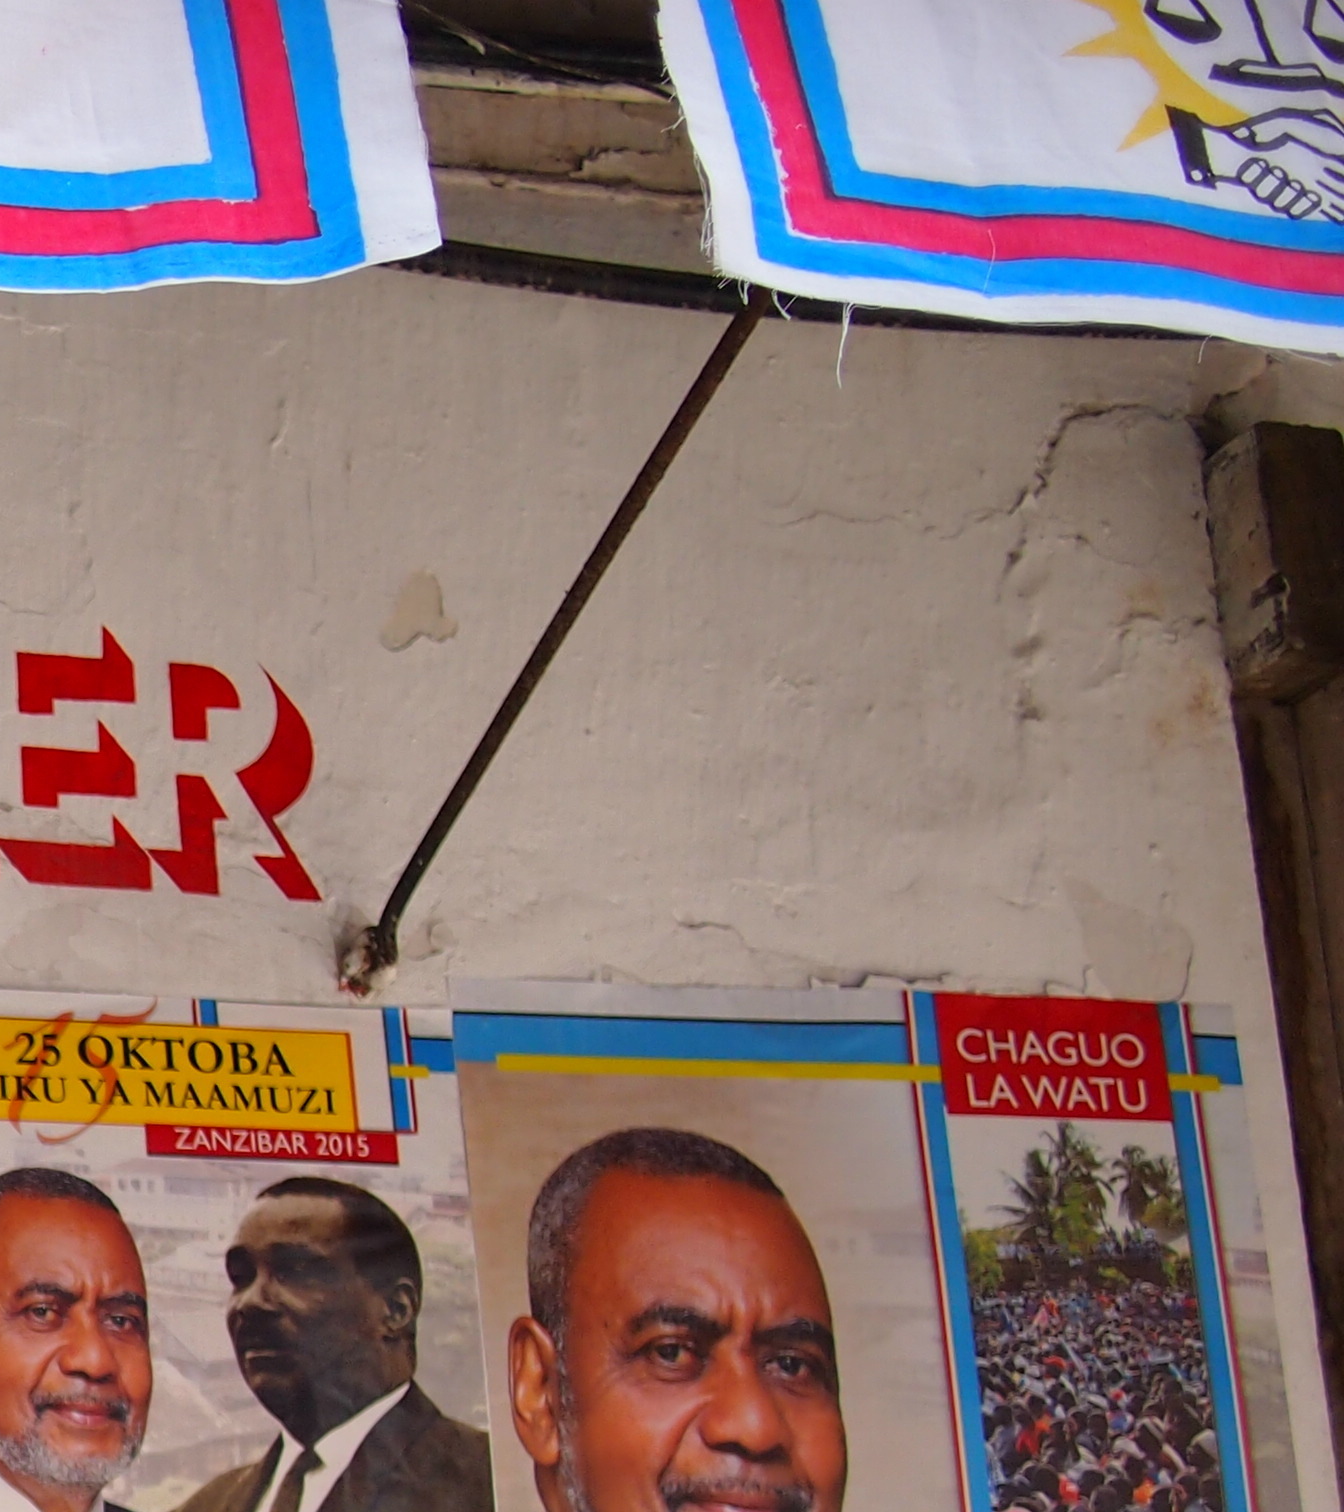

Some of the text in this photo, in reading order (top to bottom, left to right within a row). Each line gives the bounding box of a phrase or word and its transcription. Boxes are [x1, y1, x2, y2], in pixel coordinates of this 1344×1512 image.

[16, 1032, 296, 1078] 25 OKTOBA
[956, 1028, 1146, 1068] CHAGUO
[81, 1078, 132, 1106] YA
[145, 1081, 336, 1115] MAAMUZI
[965, 1073, 1148, 1113] LA WATU
[174, 1127, 370, 1157] ZANZIBAR 2015
